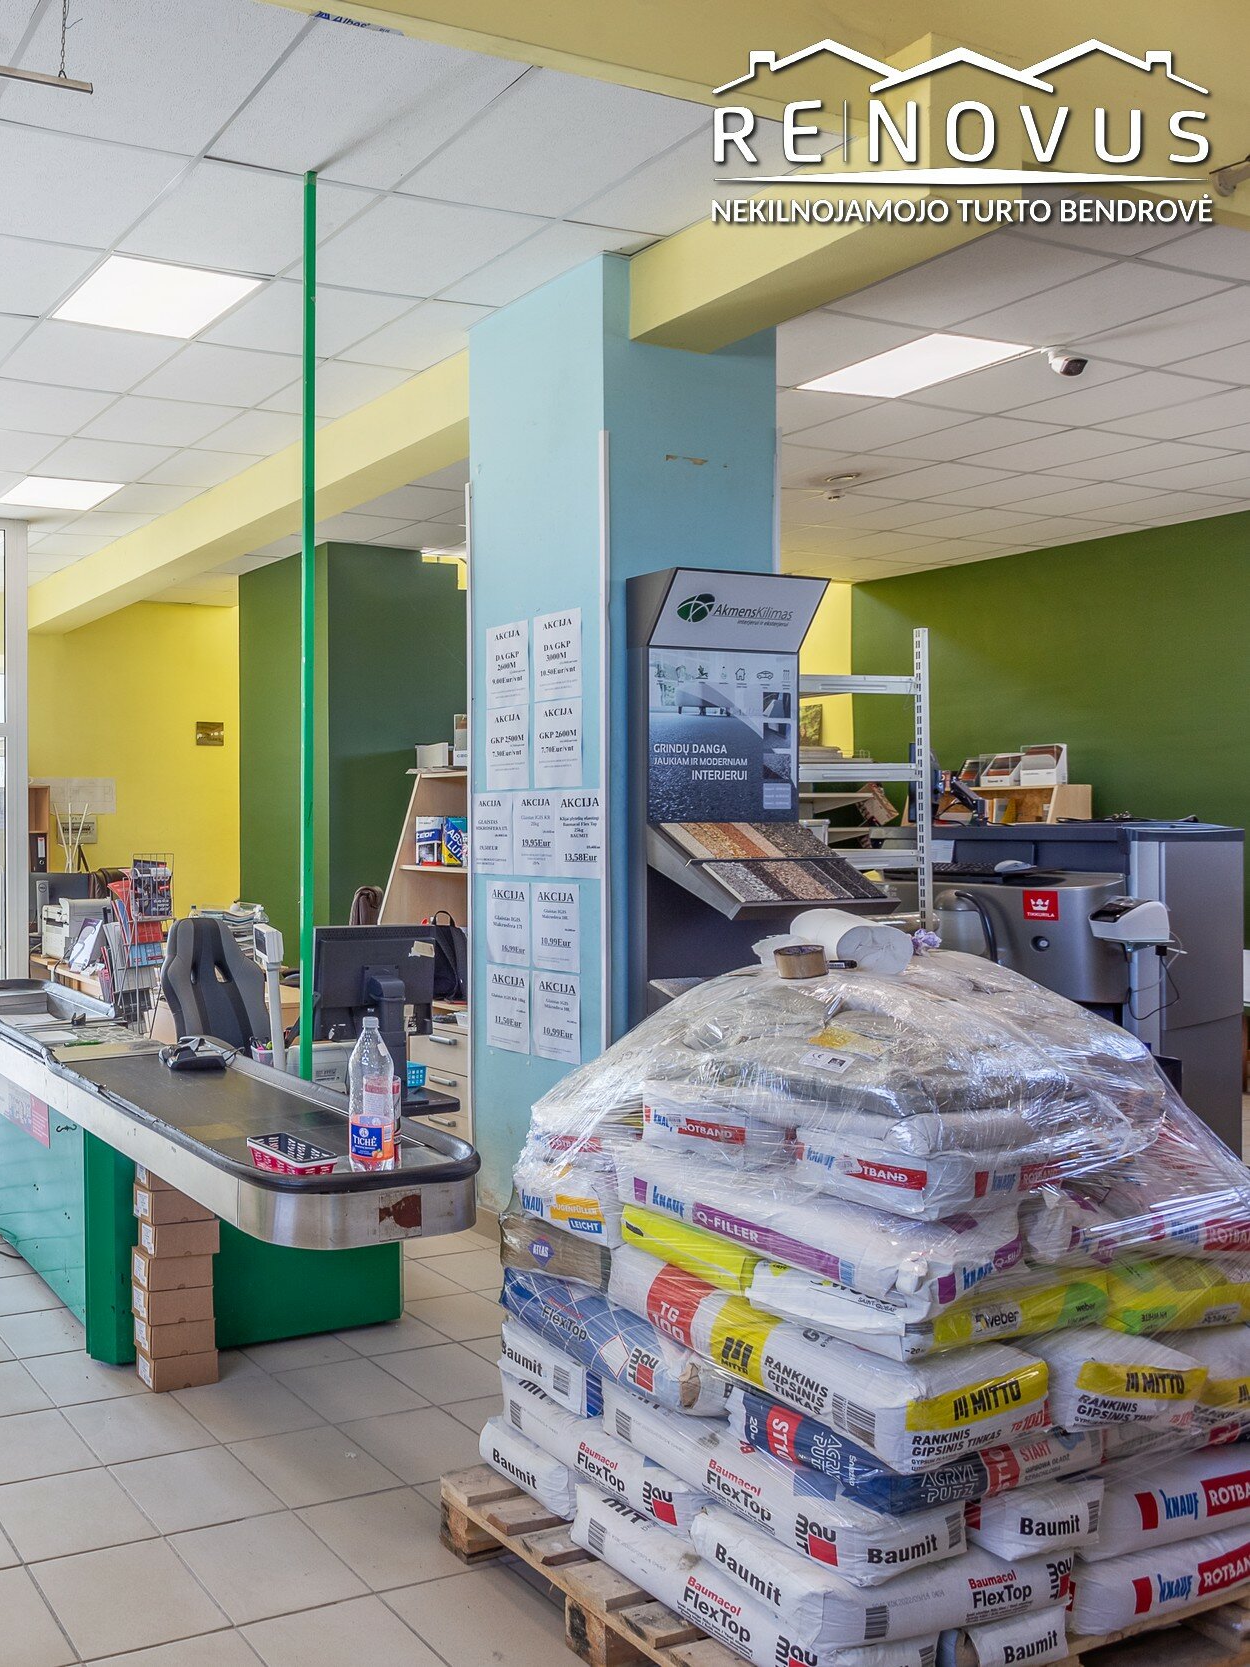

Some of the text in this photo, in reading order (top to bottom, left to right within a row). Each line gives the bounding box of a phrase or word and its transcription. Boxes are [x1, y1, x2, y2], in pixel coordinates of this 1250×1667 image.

[714, 604, 793, 621] AkmensKilimas
[543, 618, 572, 630] AKCIJA
[494, 630, 520, 641] AKCIJA
[554, 640, 571, 650] GKP
[505, 651, 520, 660] GKP
[497, 662, 516, 671] 2600M
[494, 713, 521, 724] AKCIJA
[544, 707, 573, 718] AKCIJA
[490, 736, 504, 745] GKP
[539, 729, 577, 740] GKP 2600M
[654, 743, 728, 756] GRINDŲ DANGA
[654, 758, 748, 767] JAUKIAM IR MODERNIAM
[692, 769, 748, 780] INTERJERUI
[521, 798, 550, 807] AKCIJA
[561, 797, 600, 808] AKCIJA
[564, 853, 597, 863] 13,58Eur
[492, 889, 525, 901] AKCIJA
[538, 891, 574, 904] AKCIJA
[492, 973, 525, 988] AKCIJA
[539, 980, 576, 996] AKCIJA
[543, 1026, 574, 1040] 10,99Eur
[570, 1220, 600, 1232] LEICHT
[696, 1210, 759, 1243] Q-FILLER
[660, 1301, 680, 1323] TG
[764, 1354, 829, 1398] RANKINIS
[1143, 1372, 1185, 1395] MITTO
[767, 1370, 825, 1408] GIPSINIS
[773, 1382, 822, 1416] TINKAS
[969, 1379, 1022, 1416] MITTO
[1077, 1405, 1130, 1422] GIPSINIS
[1078, 1394, 1138, 1413] RANKINIS
[911, 1429, 971, 1446] RANKINIS
[911, 1429, 1002, 1457] GIPSINIS TINKAS
[579, 1441, 619, 1471] Baumacol
[1020, 1440, 1052, 1462] START
[492, 1448, 538, 1490] Baumit
[577, 1451, 626, 1493] FlexTop
[708, 1459, 762, 1497] Baumacol
[921, 1464, 980, 1488] ACRYL
[706, 1469, 772, 1522] FlexTop
[1158, 1489, 1200, 1520] KNAUF
[1019, 1514, 1080, 1536] Baumit
[867, 1534, 938, 1565] Baumit
[715, 1543, 782, 1607] Baumit
[967, 1569, 1017, 1590] Baumacol
[687, 1576, 742, 1617] Baumacol
[972, 1584, 1033, 1609] FlexTop
[1157, 1573, 1193, 1603] KNAUF
[683, 1586, 751, 1643] FlexTop
[1003, 1629, 1059, 1665] Baumit
